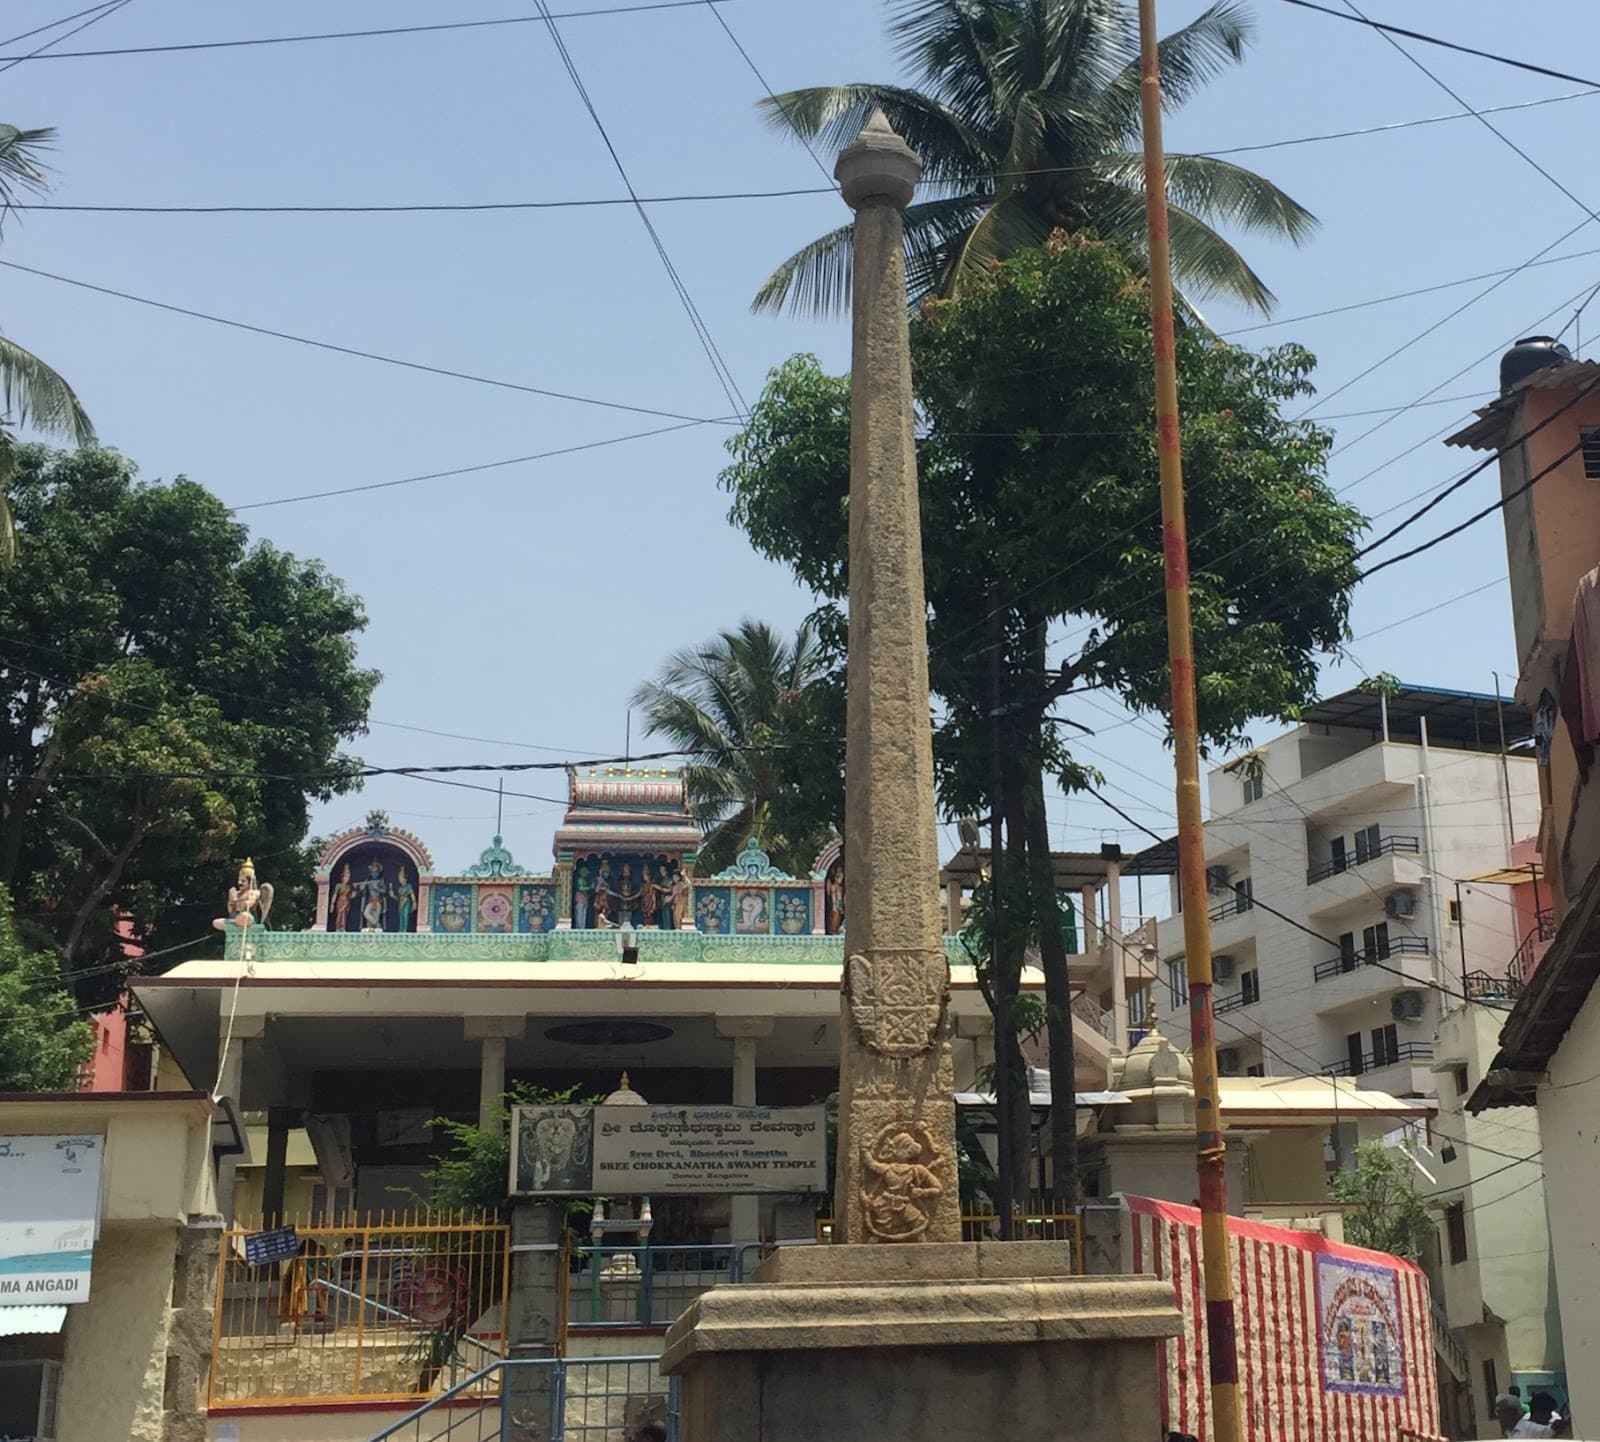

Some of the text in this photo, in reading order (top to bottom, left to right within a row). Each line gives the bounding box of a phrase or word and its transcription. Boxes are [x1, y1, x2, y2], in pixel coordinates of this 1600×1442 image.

[600, 1122, 622, 1136] ಶ್ರೀ
[750, 1120, 816, 1137] ದೇವಸ್ಥಾನ
[630, 1150, 653, 1158] Sree
[600, 1160, 817, 1171] SREE CHOKKANATHA SWAMY TEMPLE
[25, 1278, 79, 1293] ANGADI
